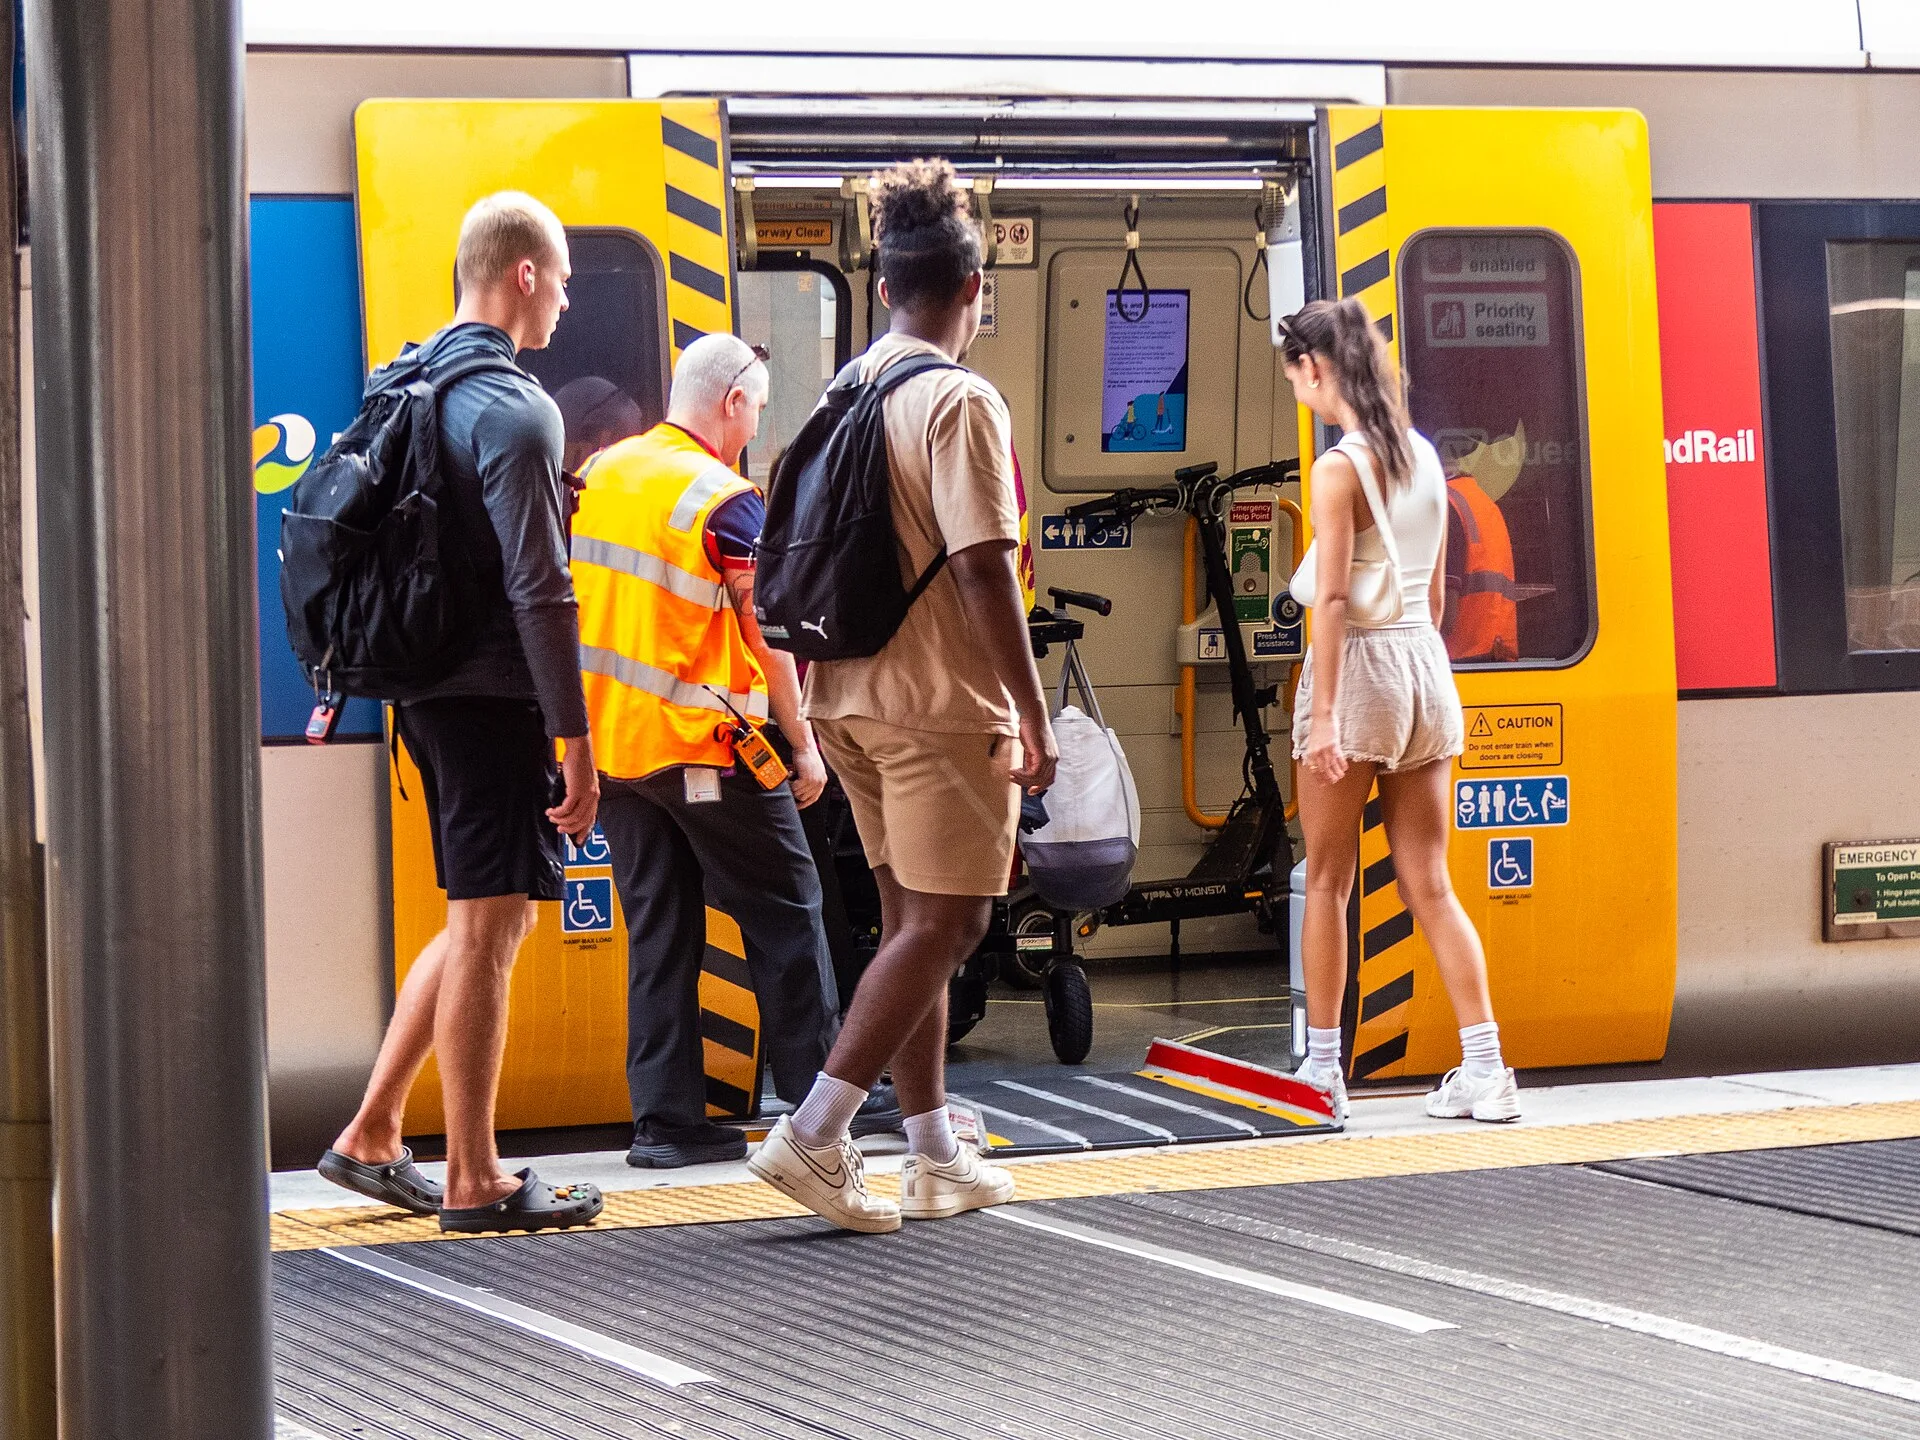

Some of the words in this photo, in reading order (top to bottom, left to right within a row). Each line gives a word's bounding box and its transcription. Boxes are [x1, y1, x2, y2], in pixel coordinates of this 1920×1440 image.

[756, 229, 792, 240] orway
[795, 227, 825, 238] Clear
[1469, 258, 1536, 272] enabled
[1474, 302, 1535, 321] Priority
[1476, 322, 1537, 341] seating
[1232, 504, 1271, 513] Emergency
[1232, 513, 1249, 521] Help
[1251, 512, 1270, 520] Point
[1257, 640, 1295, 648] assistance
[1497, 716, 1553, 729] CAUTION
[1468, 743, 1479, 751] Do
[1495, 742, 1513, 750] enter
[1515, 741, 1532, 749] train
[1534, 740, 1553, 748] when
[1480, 753, 1501, 761] doors
[1516, 751, 1543, 760] closing
[1839, 849, 1917, 864] EMERGENCY
[1875, 872, 1886, 882] To
[1887, 871, 1909, 883] Open
[1185, 885, 1226, 897] MONSTA
